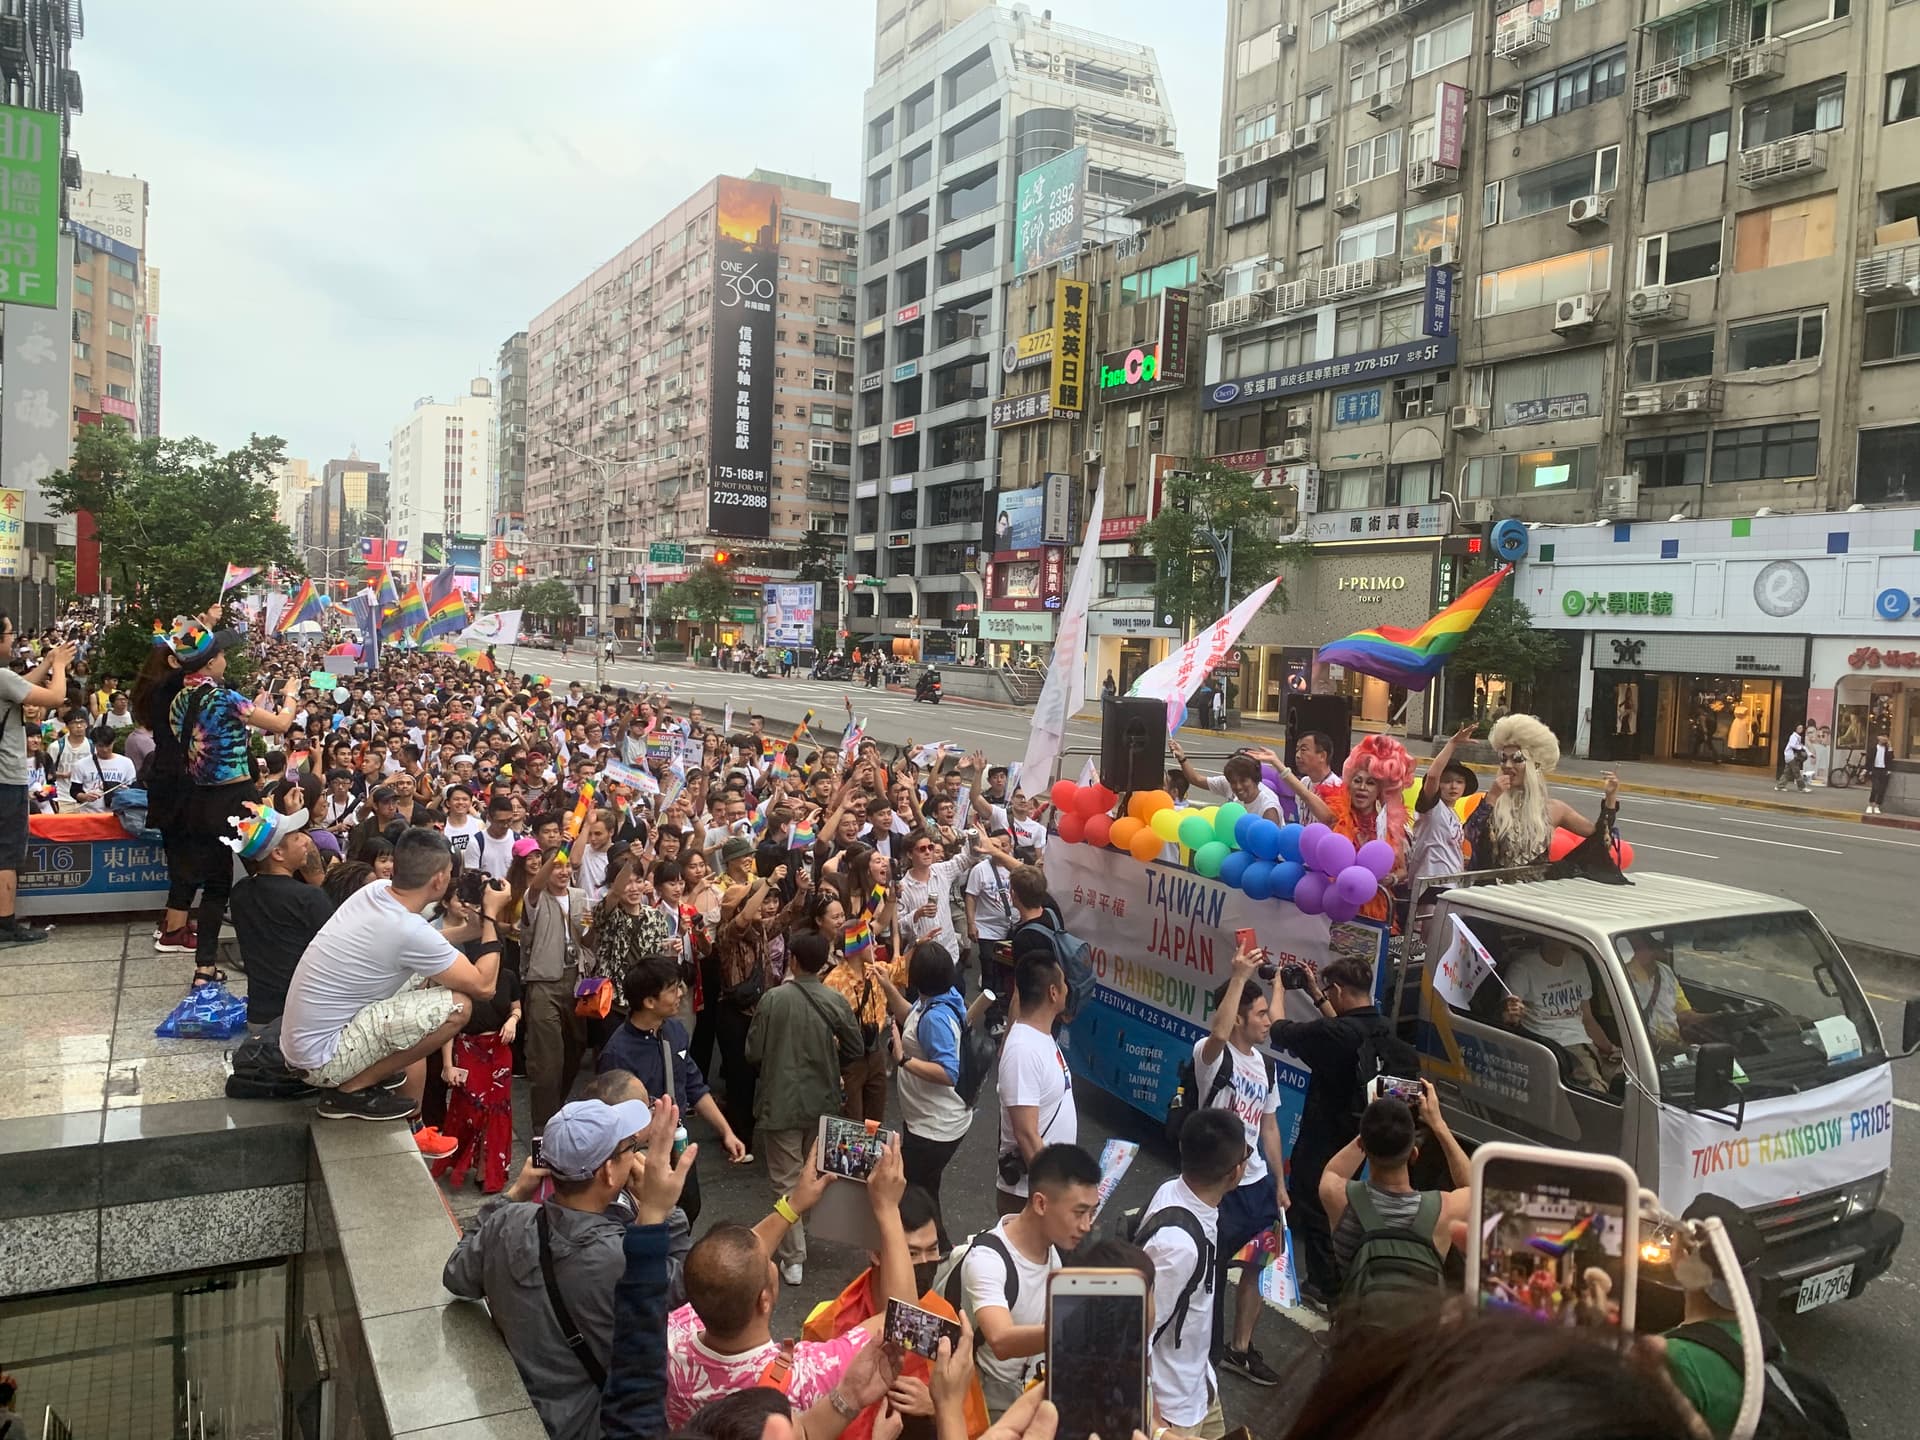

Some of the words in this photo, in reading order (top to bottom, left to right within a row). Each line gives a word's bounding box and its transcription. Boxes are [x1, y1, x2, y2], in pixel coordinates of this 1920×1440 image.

[1049, 182, 1075, 210] 2392
[1048, 206, 1074, 231] 5888
[721, 260, 743, 274] ONE
[720, 263, 774, 307] 360
[1433, 269, 1447, 319] 雪瑞爾
[1433, 320, 1444, 332] 5F
[1243, 377, 1278, 396] 雪瑞爾
[1354, 353, 1400, 373] 2778-1517
[713, 492, 768, 508] 2723-2888
[1350, 512, 1420, 533] 魔術真髮
[1586, 591, 1673, 616] 大學眼鏡
[90, 772, 123, 781] TAWAN
[32, 846, 74, 872] 16
[109, 872, 136, 883] East
[1073, 884, 1127, 918] 台灣平權
[1145, 868, 1227, 929] TAIWAN
[1147, 917, 1214, 975] JAPAN
[1113, 955, 1197, 1016] RAINBOW
[1541, 984, 1583, 1008] TAIWAN
[1100, 990, 1136, 1015] FESTIVAL
[1139, 1008, 1158, 1025] 4.25
[1161, 1017, 1178, 1033] SAT
[1180, 1026, 1186, 1037] &
[1125, 1043, 1164, 1058] TOGETHER
[1138, 1061, 1161, 1073] MAKE
[1280, 1069, 1306, 1088] AND
[1128, 1073, 1159, 1088] TAIWAN
[1132, 1089, 1157, 1103] BETTER
[1692, 1137, 1750, 1178] TOKYO
[1758, 1117, 1842, 1165] RAINBOW
[1850, 1101, 1891, 1142] PRIDE
[1799, 1274, 1850, 1308] RAA-7906
